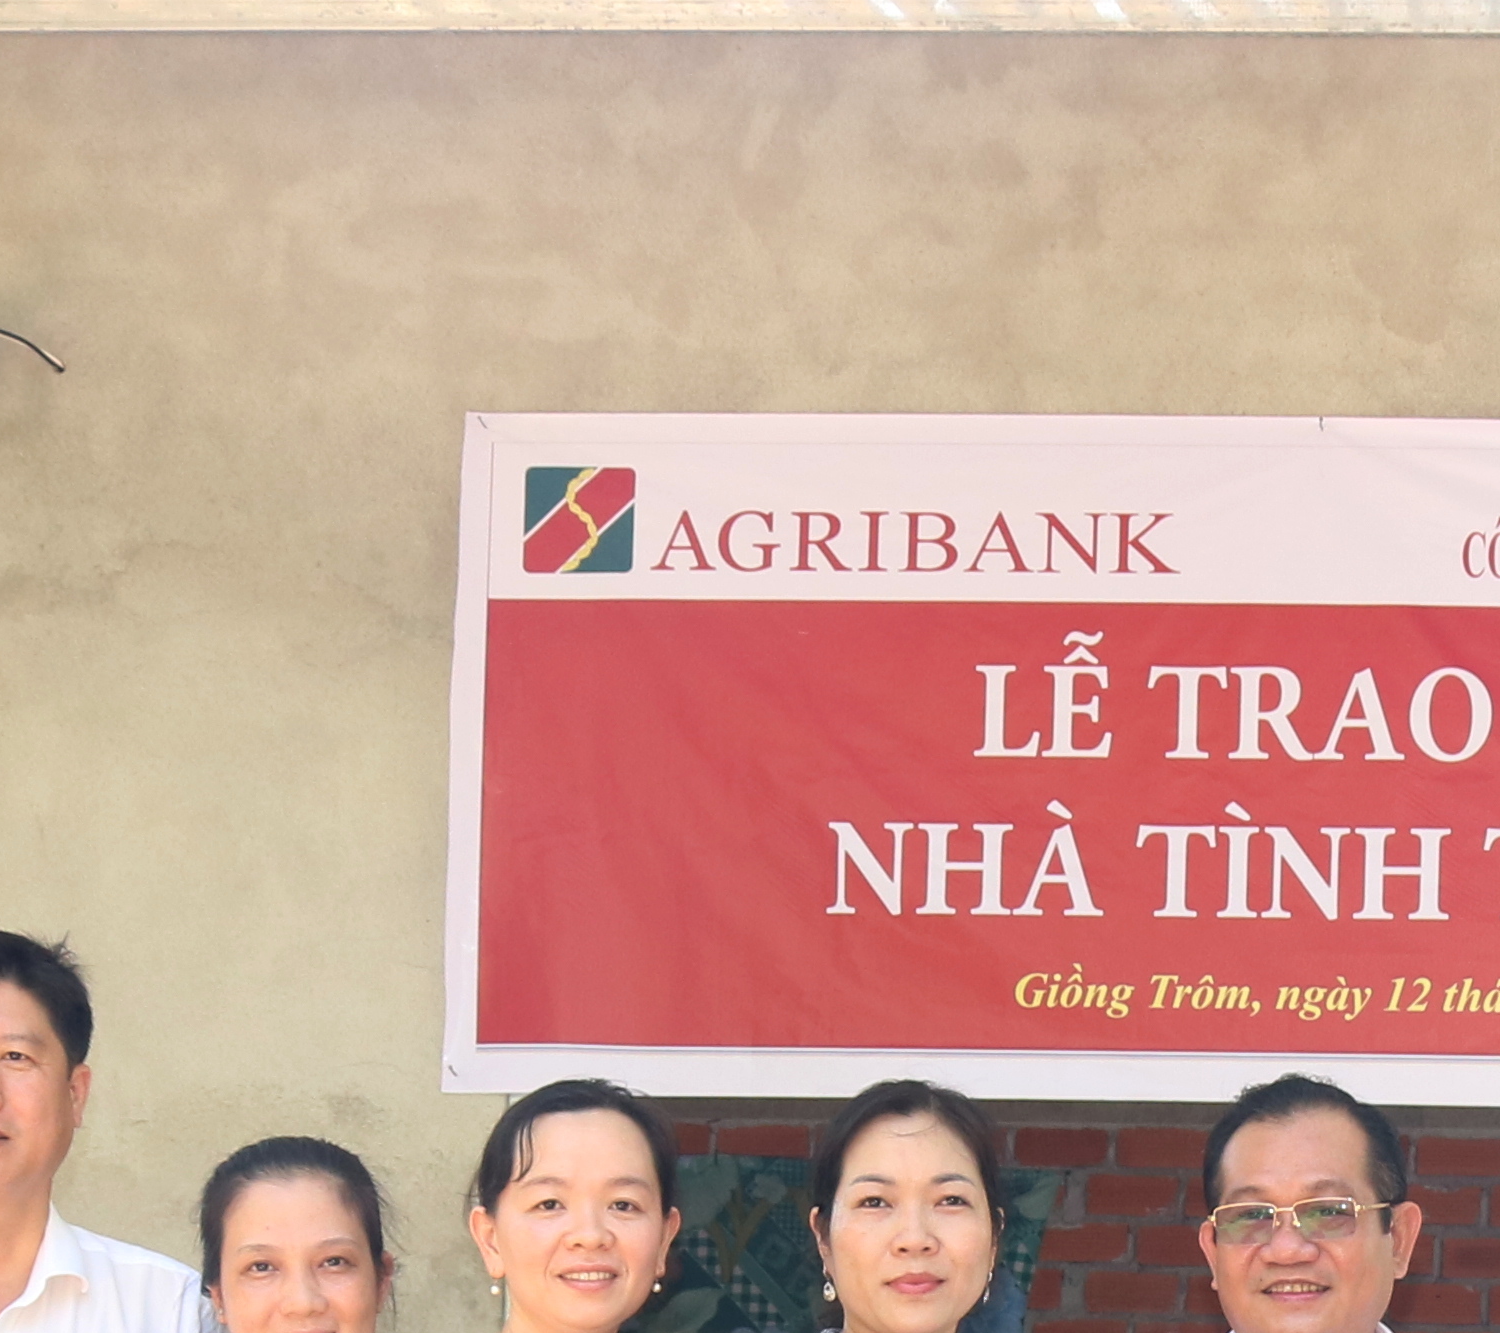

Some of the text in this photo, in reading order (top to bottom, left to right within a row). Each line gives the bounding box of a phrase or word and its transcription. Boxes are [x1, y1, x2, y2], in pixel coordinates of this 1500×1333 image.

[650, 509, 1181, 575] AGRIBANK
[973, 631, 1112, 759] LỄ
[1147, 664, 1493, 763] TRAO
[826, 799, 1104, 917] NHÀ
[1136, 801, 1452, 921] TÌNH
[1014, 963, 1134, 1019] Giồng
[1150, 974, 1262, 1018] Trôm,
[1276, 976, 1373, 1022] ngày
[1387, 976, 1432, 1013] 12
